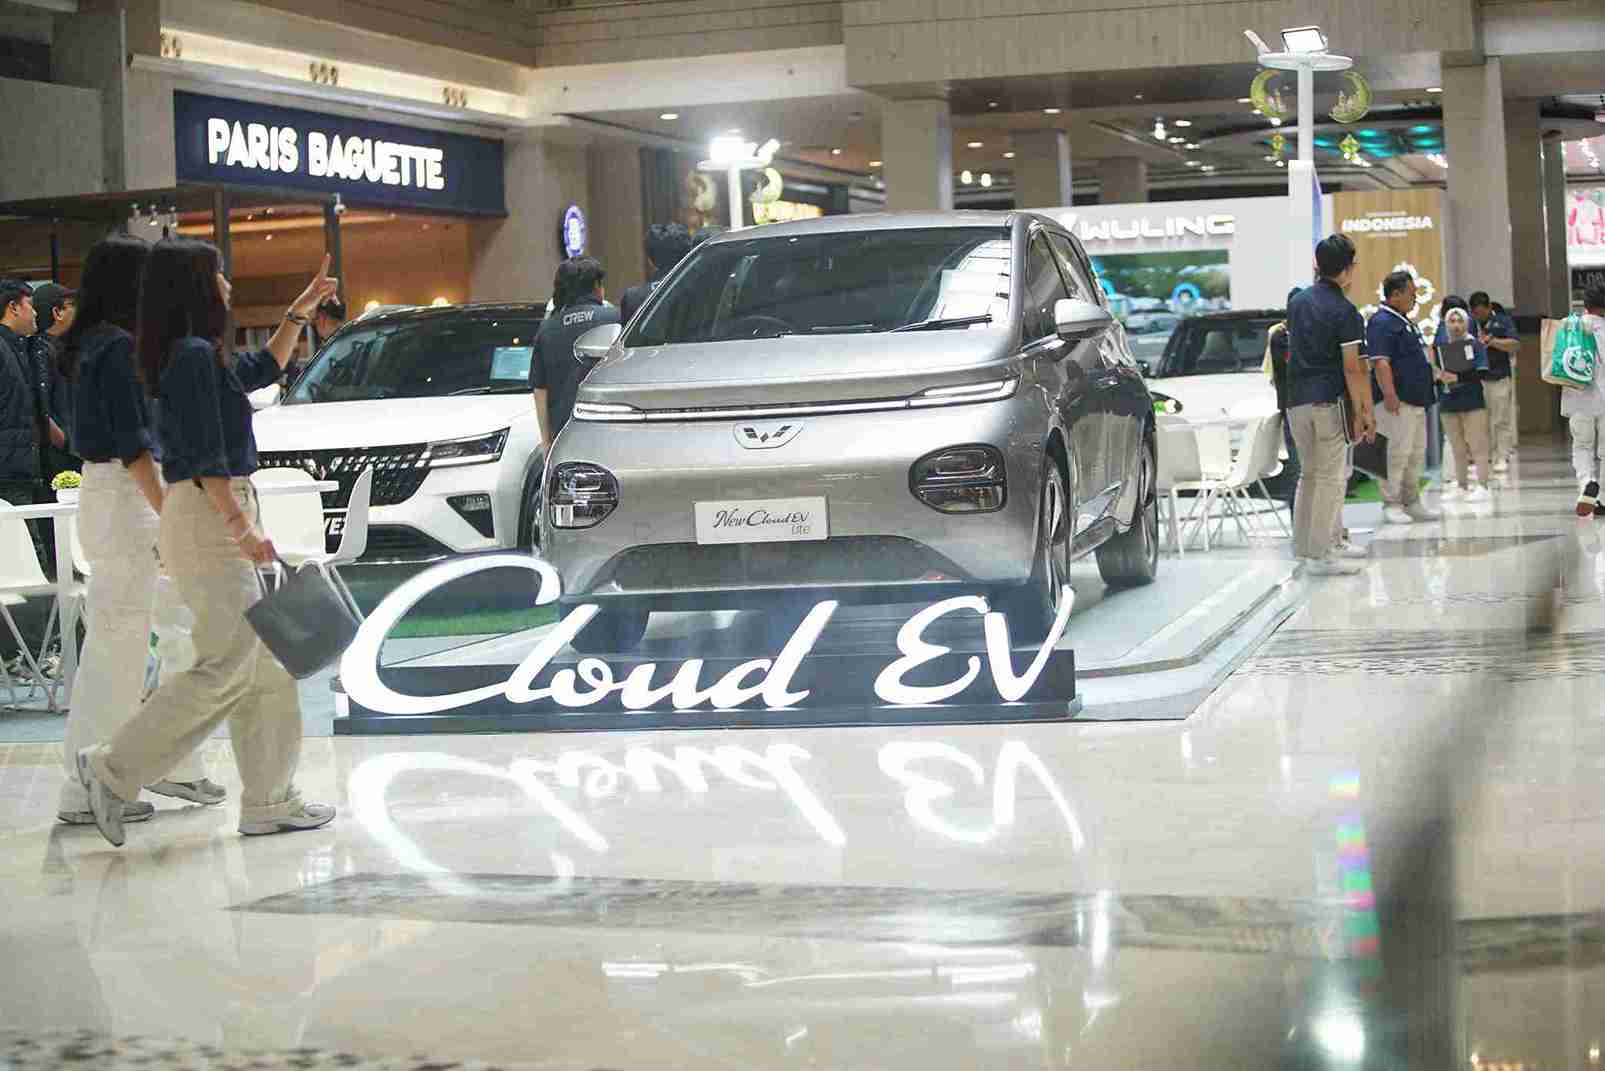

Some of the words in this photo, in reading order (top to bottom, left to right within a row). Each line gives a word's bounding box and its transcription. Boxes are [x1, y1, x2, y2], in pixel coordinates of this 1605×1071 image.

[208, 118, 299, 173] PARIS
[308, 131, 444, 190] BAGUETTE
[1079, 214, 1236, 241] WULING
[1342, 216, 1433, 232] INDONESIA
[563, 310, 594, 325] CREW
[713, 508, 745, 528] New
[746, 510, 791, 526] Cloud
[791, 511, 809, 523] EV
[340, 554, 838, 714] Cloud
[874, 585, 1075, 707] EV
